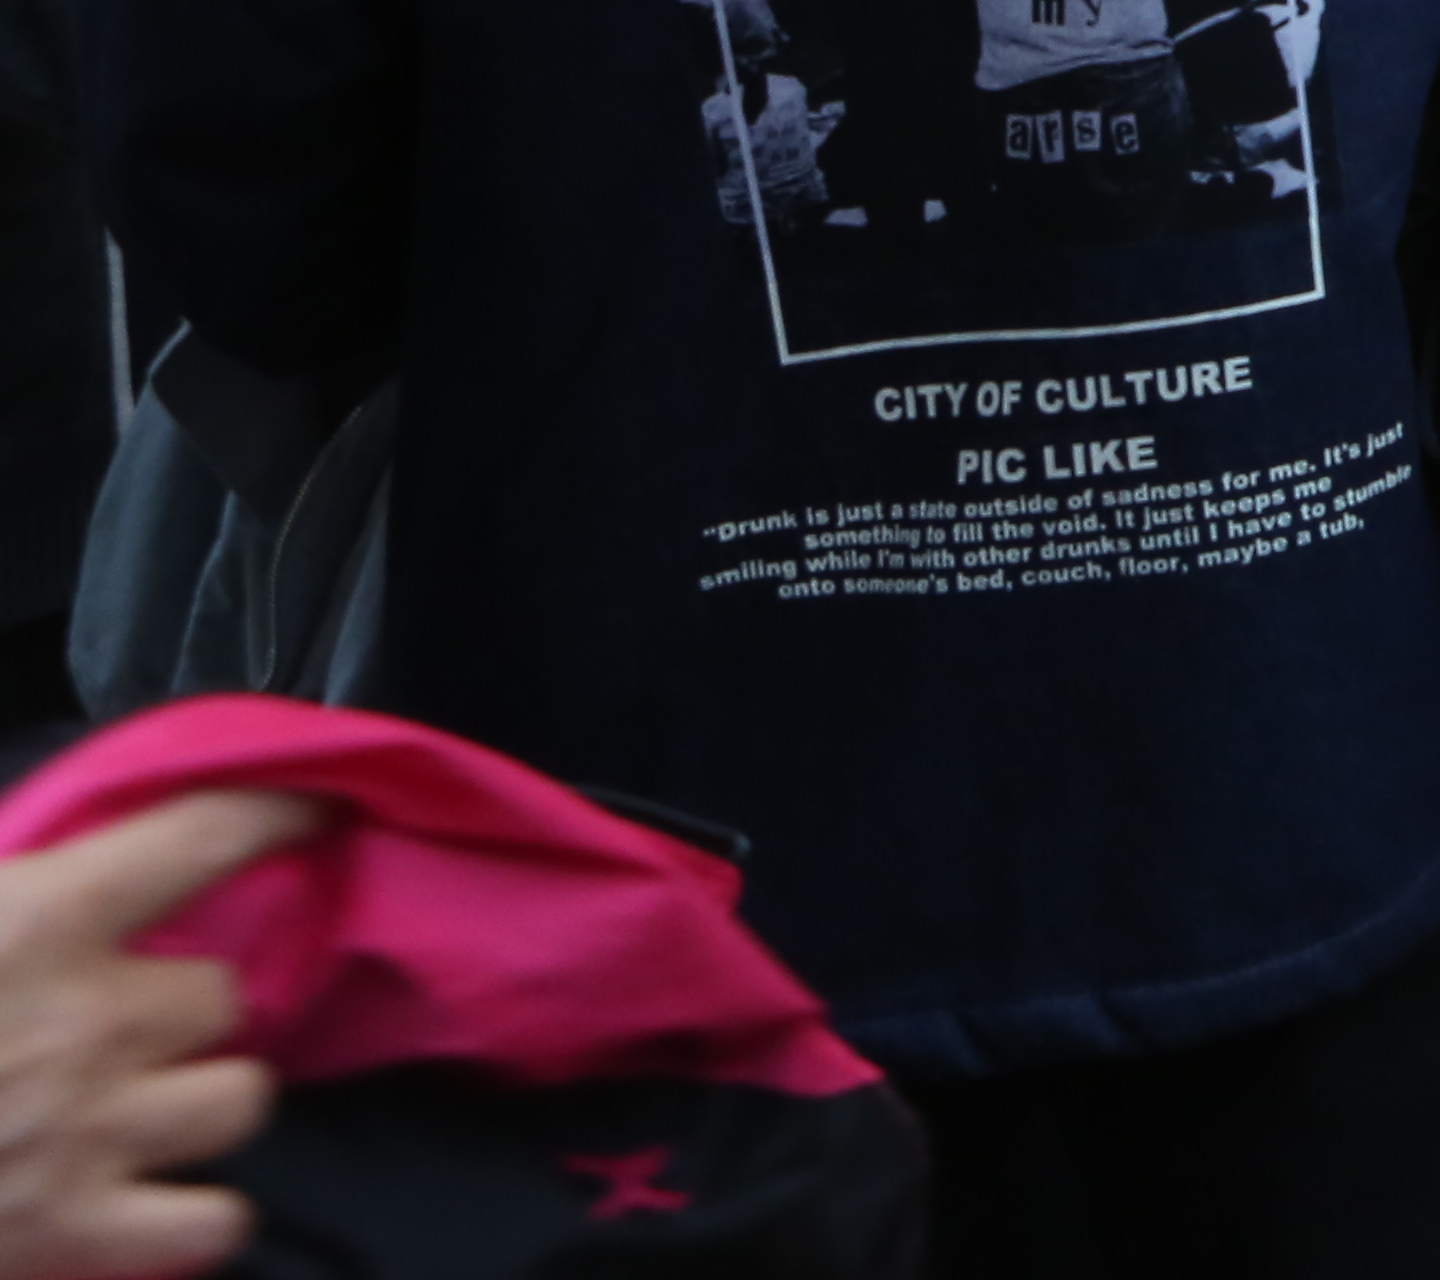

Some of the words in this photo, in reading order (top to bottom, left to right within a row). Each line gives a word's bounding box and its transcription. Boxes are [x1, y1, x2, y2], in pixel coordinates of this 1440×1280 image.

[1006, 113, 1138, 162] arse
[874, 383, 968, 422] CITY
[976, 381, 1023, 417] OF
[1036, 356, 1252, 414] CULTURE
[806, 506, 829, 526] is
[837, 501, 884, 527] just
[891, 503, 904, 520] a
[909, 500, 957, 520] state
[964, 494, 1058, 519] outside
[1068, 489, 1094, 510] of
[1102, 479, 1213, 506] sadness
[1221, 470, 1261, 490] for
[1268, 459, 1317, 482] me.
[1323, 443, 1361, 469] It's
[1366, 421, 1404, 458] just
[957, 448, 1027, 485] PIC
[1042, 435, 1158, 479] LIKE
[699, 558, 798, 591] smiling
[805, 547, 872, 574] while
[909, 544, 956, 571] with
[963, 541, 1032, 568] other
[1040, 535, 1132, 562] drunks
[1139, 526, 1201, 552] until
[1209, 522, 1219, 542] I
[1227, 511, 1293, 540] have
[1299, 500, 1327, 523] to
[804, 523, 921, 551] something
[926, 523, 947, 544] to
[952, 520, 984, 542] fill
[991, 518, 1035, 541] the
[1043, 513, 1106, 538] void.
[1114, 507, 1136, 529] It
[1142, 501, 1195, 532] just
[1203, 489, 1287, 521] keeps
[1293, 476, 1333, 500] me
[777, 576, 836, 600] onto
[844, 572, 949, 595] someone's
[956, 568, 1014, 593] bed,
[1021, 558, 1112, 587] couch,
[1118, 554, 1190, 579] floor,
[1196, 536, 1289, 568] maybe
[1295, 529, 1313, 547] a
